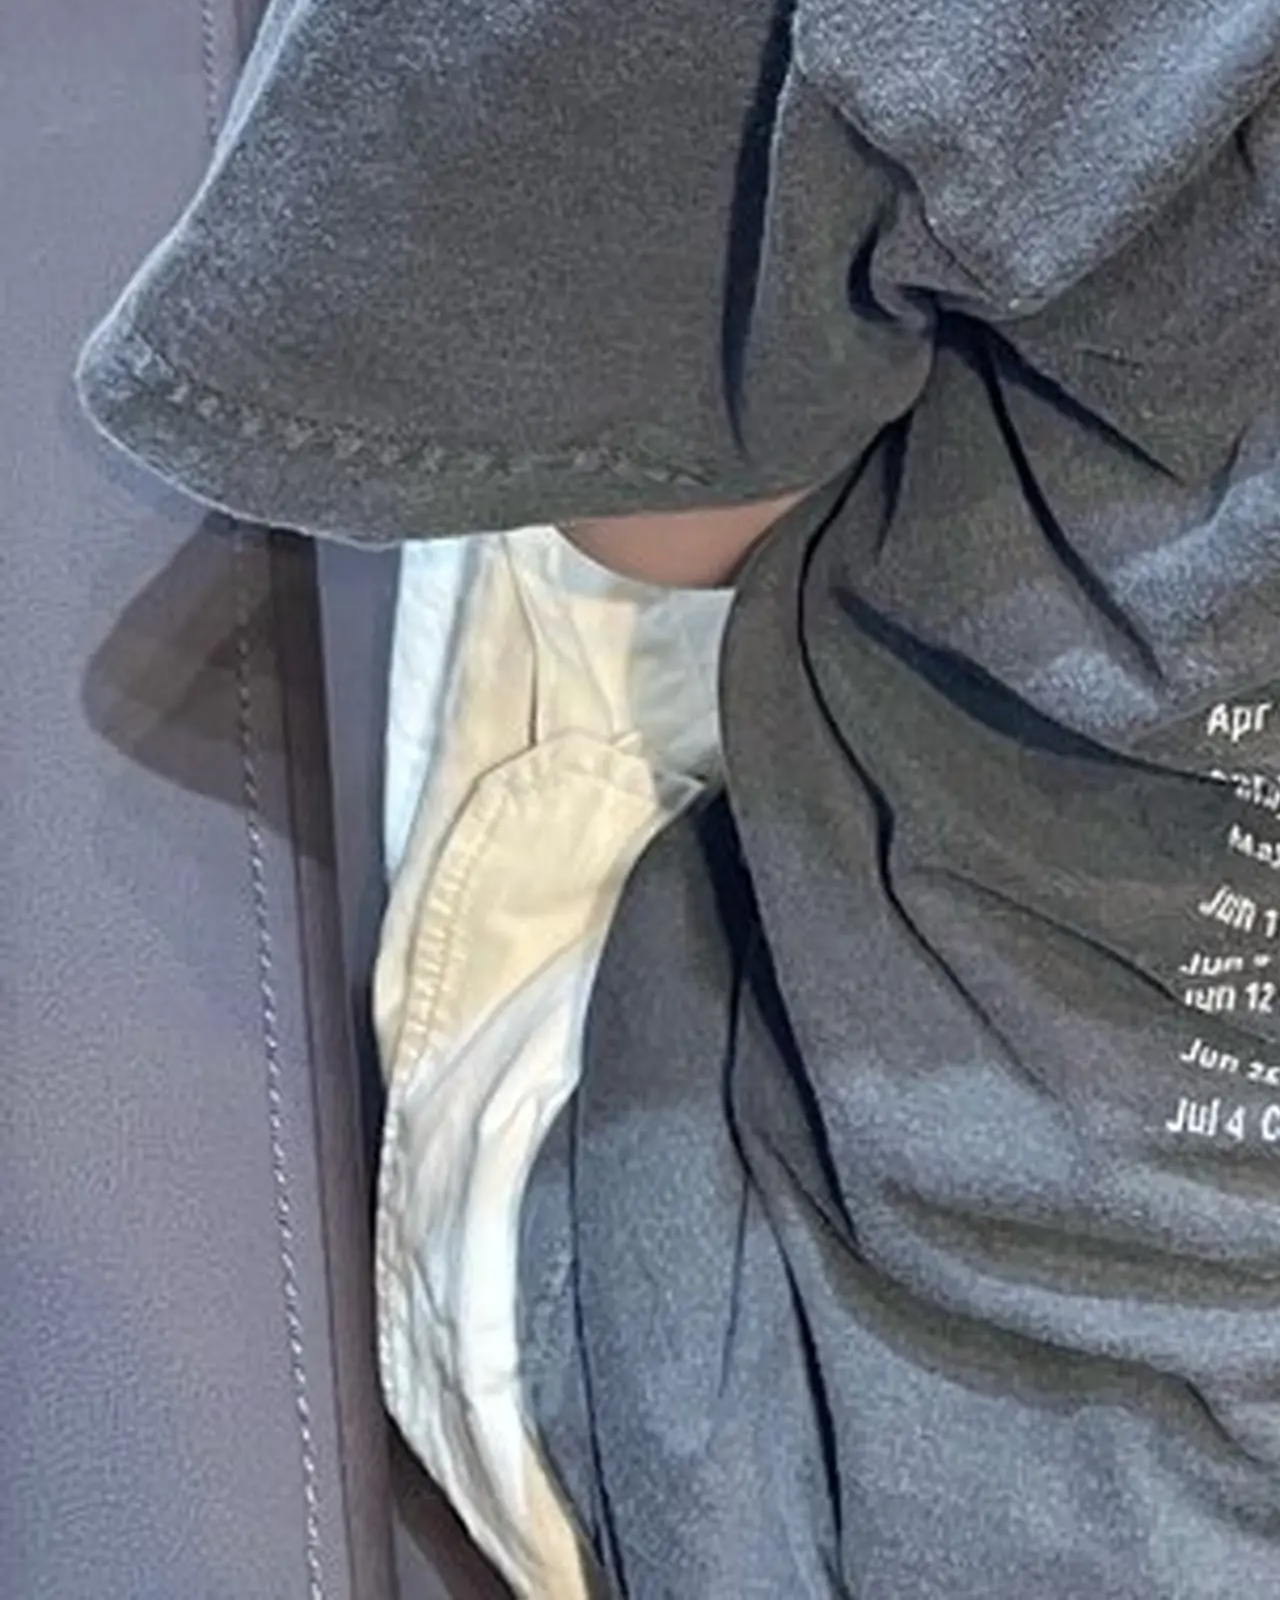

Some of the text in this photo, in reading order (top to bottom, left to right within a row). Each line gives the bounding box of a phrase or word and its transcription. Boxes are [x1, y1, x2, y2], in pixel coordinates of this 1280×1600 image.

[1206, 703, 1272, 743] Apr
[1199, 884, 1257, 933] Jun
[1264, 908, 1280, 939] 1
[1245, 981, 1277, 1014] 12
[1166, 1098, 1222, 1138] Jul
[1225, 1107, 1246, 1141] 4
